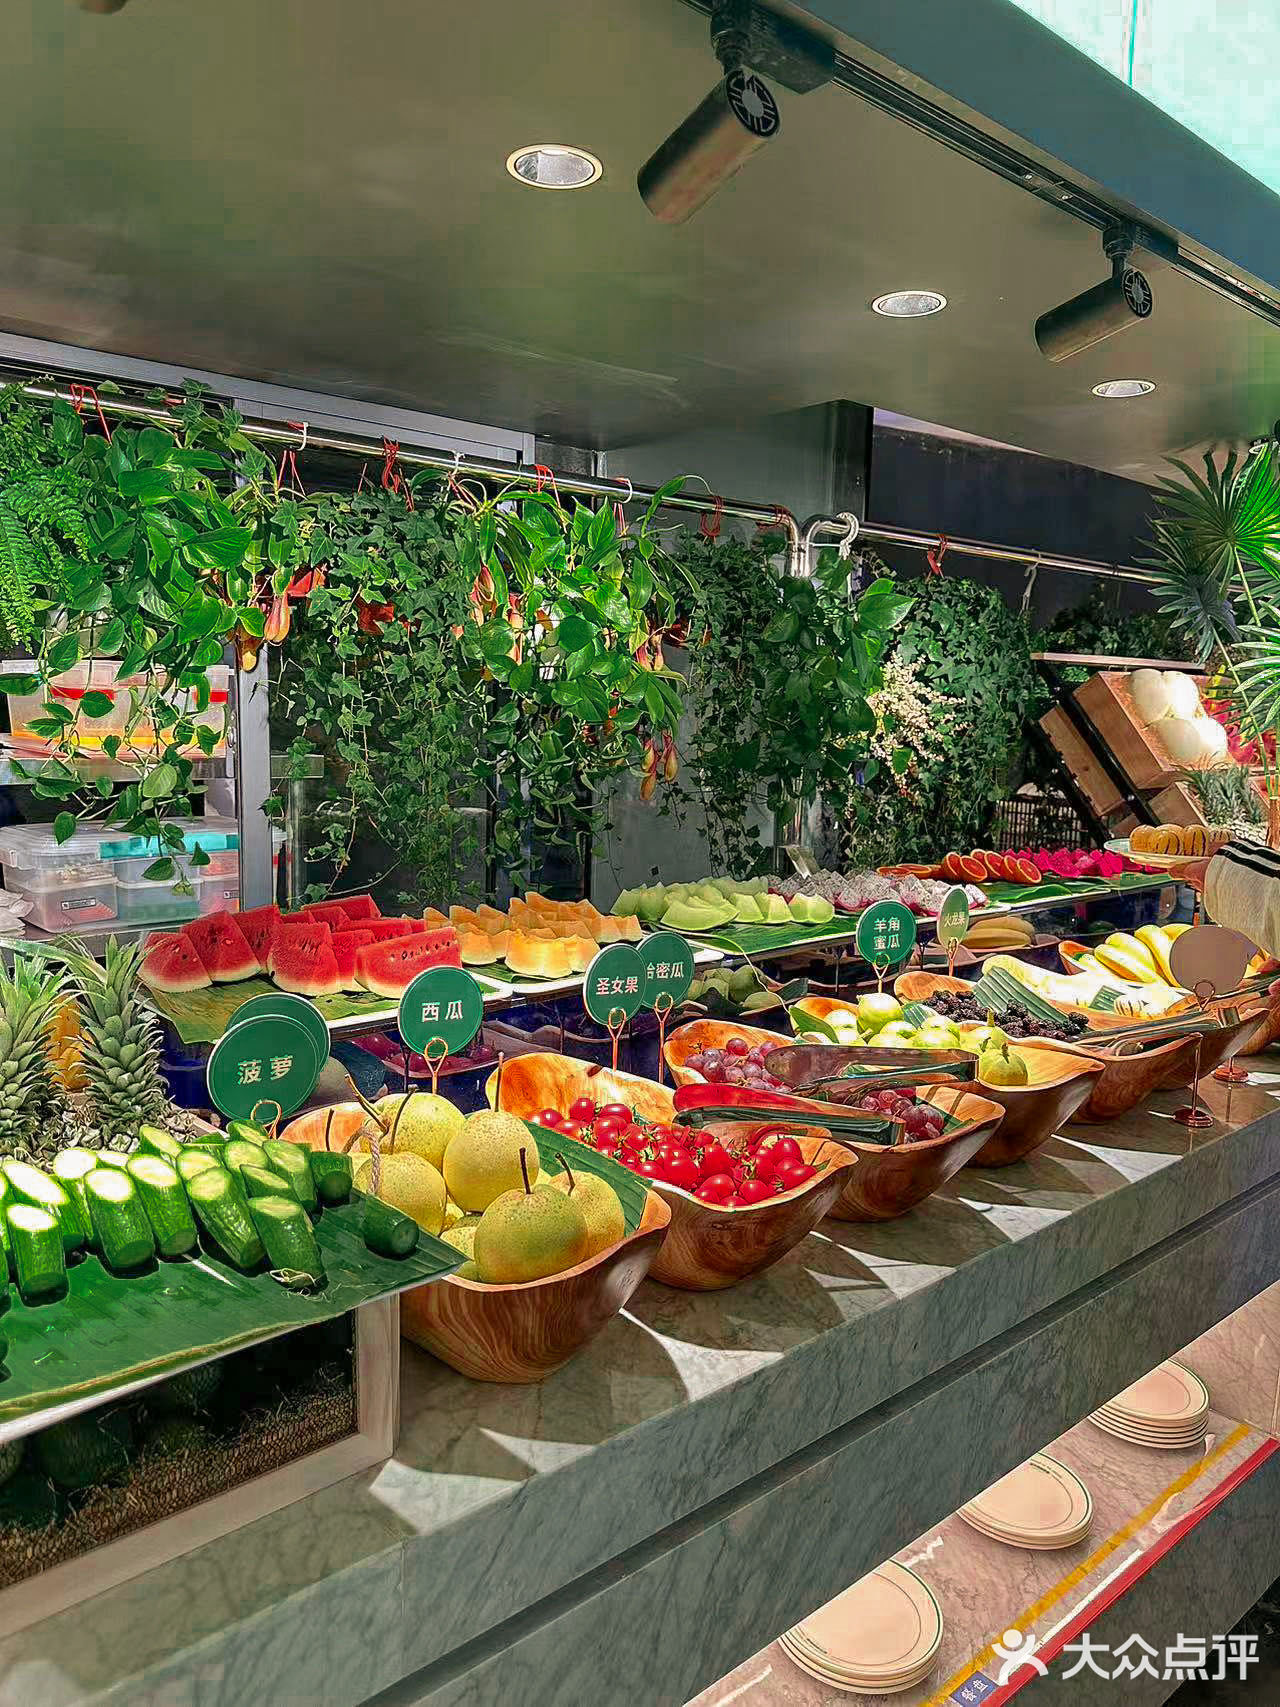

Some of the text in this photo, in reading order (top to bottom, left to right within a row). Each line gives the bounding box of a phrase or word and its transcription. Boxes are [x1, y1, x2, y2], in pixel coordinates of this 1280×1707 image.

[874, 917, 900, 932] 羊角
[873, 934, 900, 950] 蜜瓜
[596, 976, 639, 995] 圣女果
[421, 1000, 463, 1022] 西瓜
[238, 1054, 293, 1084] 菠萝
